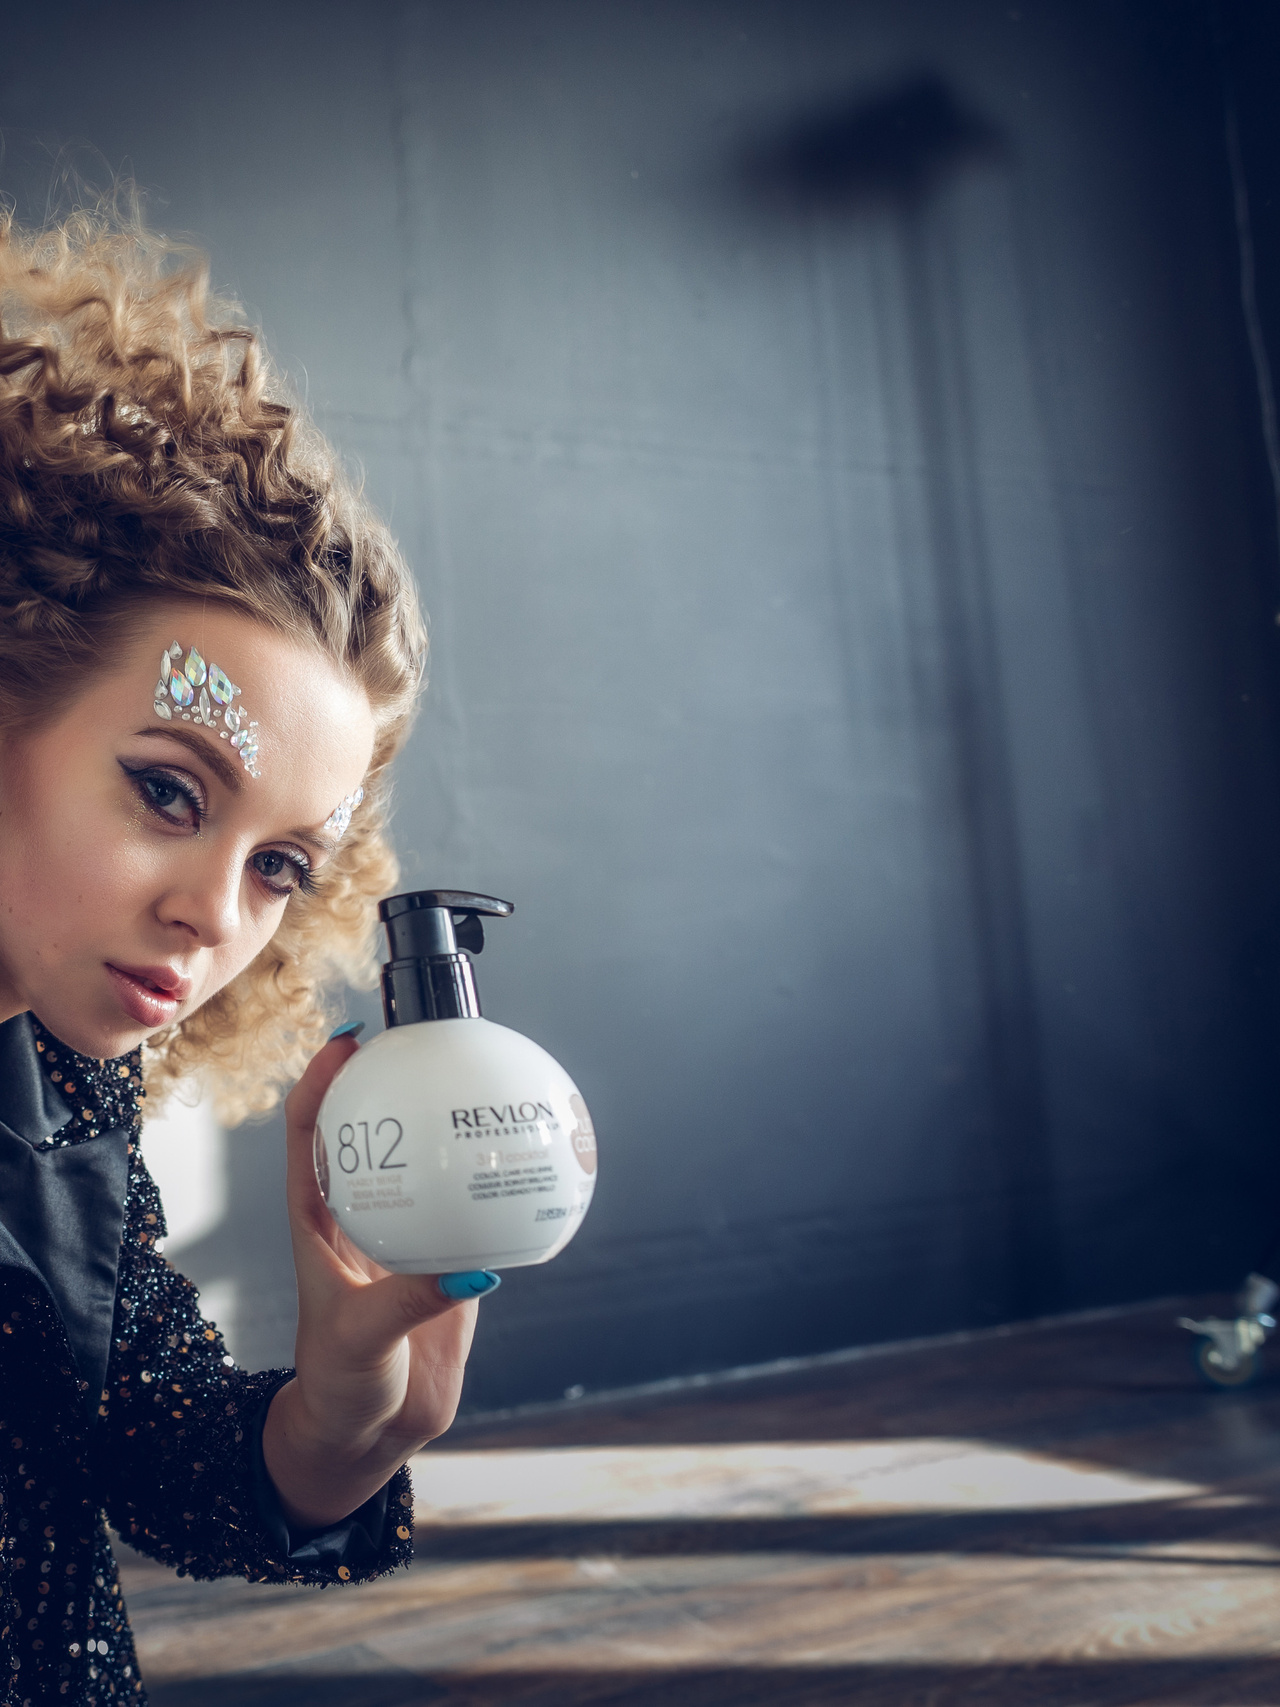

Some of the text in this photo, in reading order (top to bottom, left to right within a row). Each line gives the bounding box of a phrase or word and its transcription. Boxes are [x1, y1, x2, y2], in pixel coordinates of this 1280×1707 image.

[451, 1101, 554, 1129] REVLON
[338, 1117, 407, 1174] 812
[455, 1123, 559, 1140] PROFESSIOL
